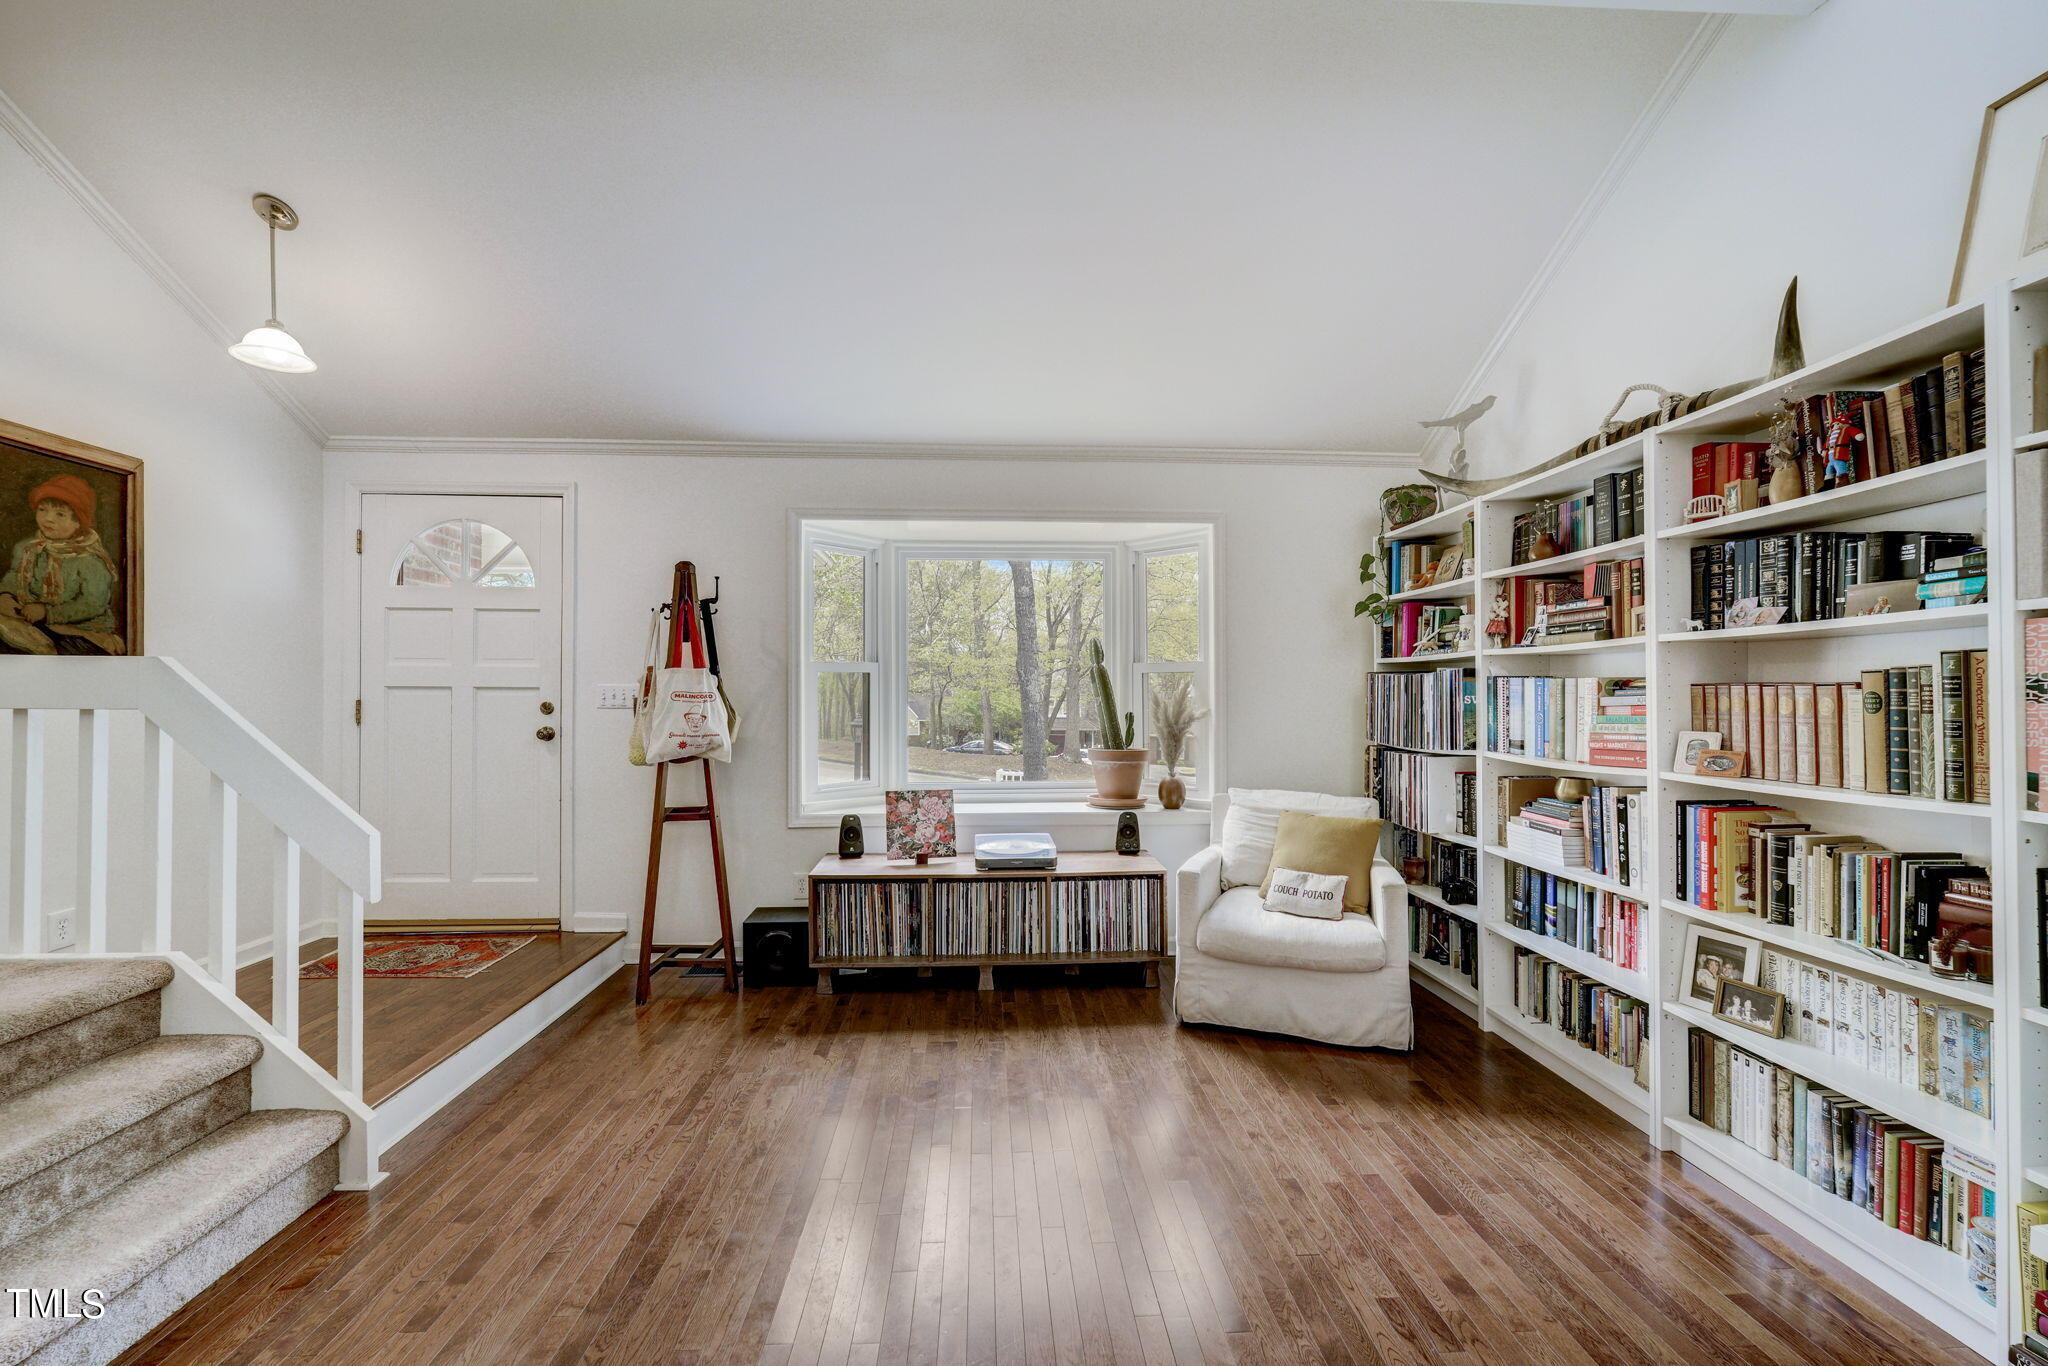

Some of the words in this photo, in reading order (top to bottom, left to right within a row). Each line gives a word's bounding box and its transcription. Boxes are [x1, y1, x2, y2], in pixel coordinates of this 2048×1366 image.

[2026, 624, 2038, 686] MODERN
[2038, 622, 2048, 667] ATLAS
[1975, 657, 1985, 666] A
[1975, 667, 1986, 720] Connecticut
[2038, 672, 2048, 692] OF
[2026, 689, 2038, 748] HOUSES
[1975, 721, 1988, 756] Yankee
[2038, 693, 2048, 790] MID-CENTURY
[1273, 884, 1299, 896] COUCH
[1302, 890, 1334, 900] POTATO
[1952, 883, 1968, 892] The
[1953, 1147, 1972, 1158] Flower
[1973, 1156, 1990, 1166] Color
[1932, 1164, 1942, 1192] Tolkien
[1946, 1160, 1968, 1174] Flower
[1970, 1171, 1990, 1184] Color
[2031, 1265, 2039, 1288] WICKED
